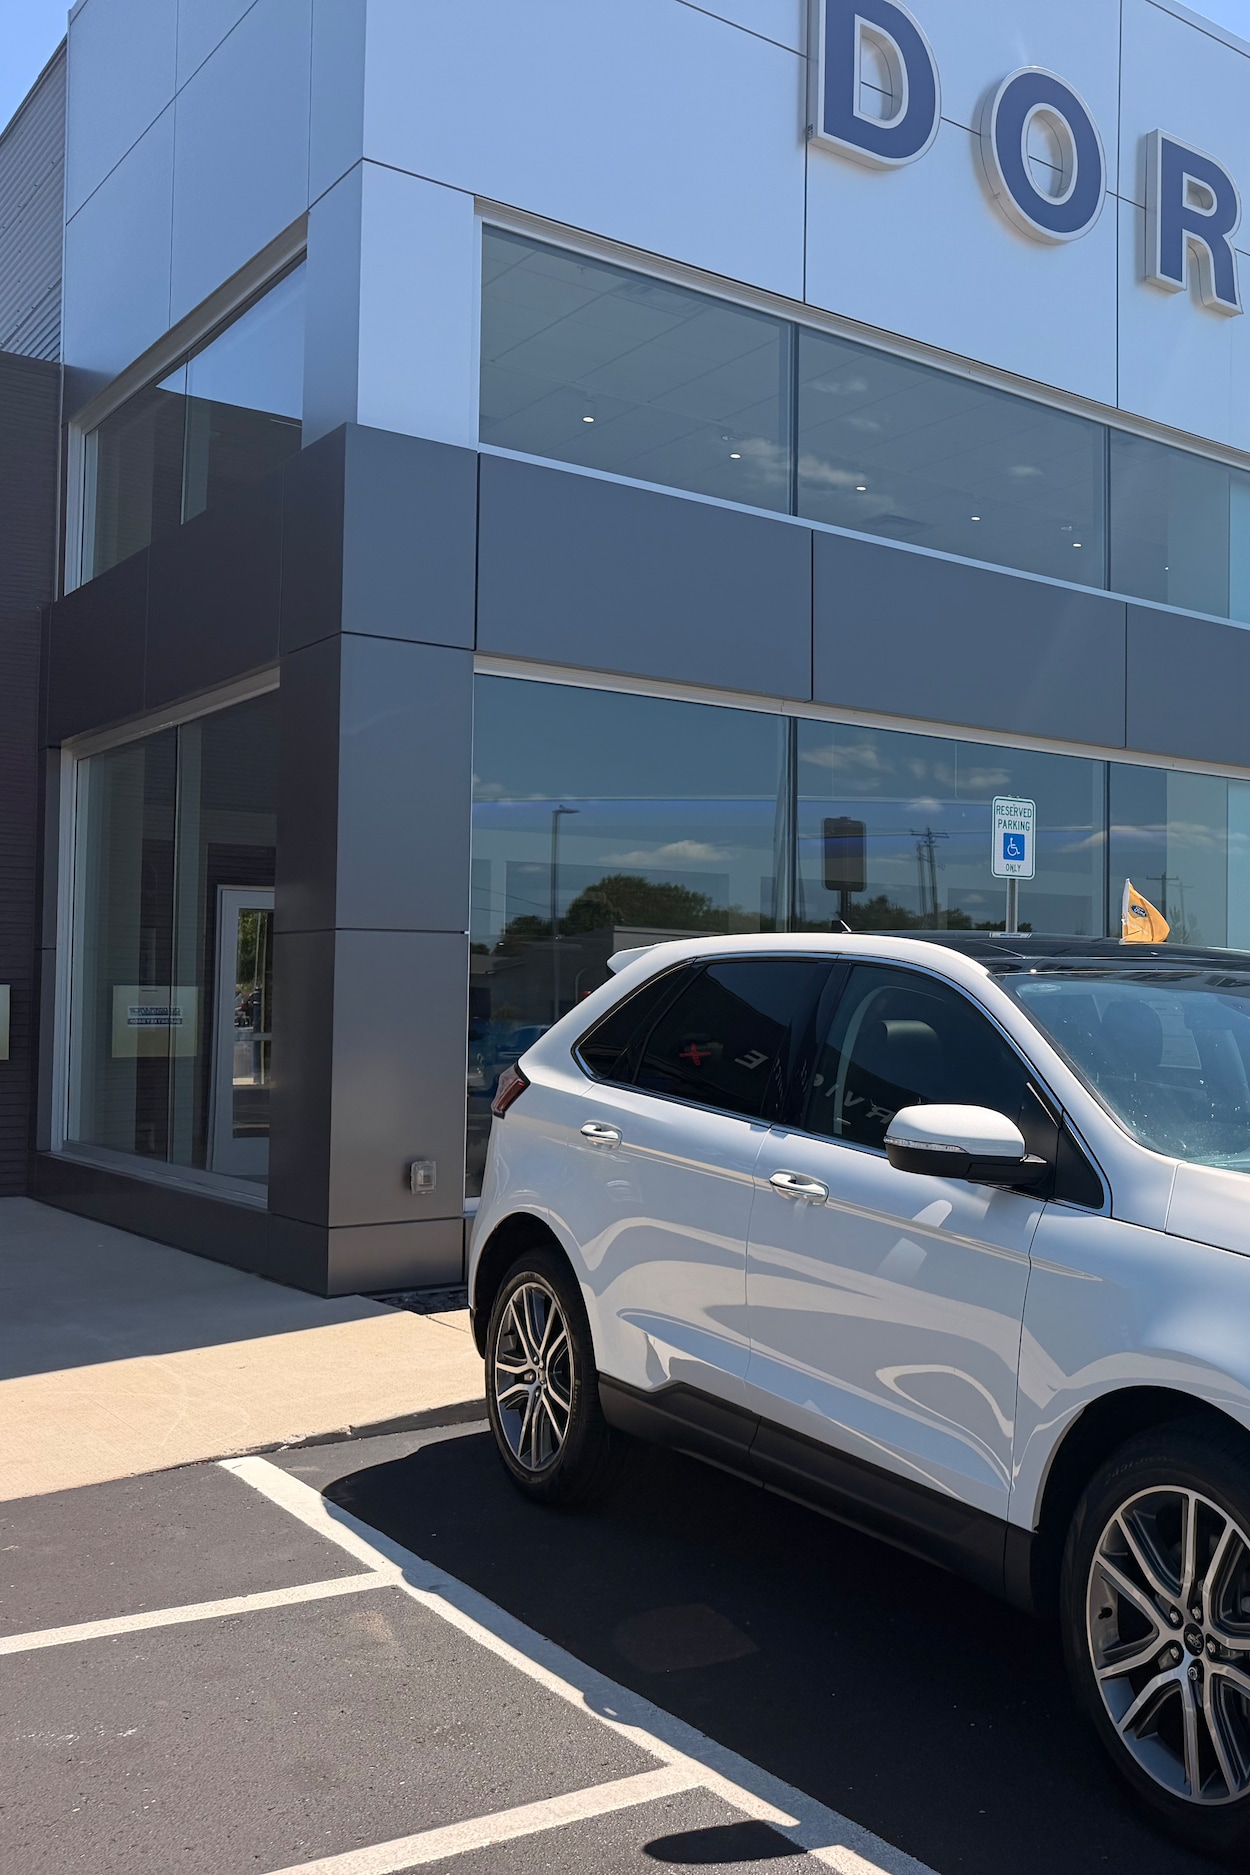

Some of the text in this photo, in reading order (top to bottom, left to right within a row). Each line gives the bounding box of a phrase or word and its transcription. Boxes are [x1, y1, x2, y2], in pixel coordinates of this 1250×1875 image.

[996, 805, 1032, 818] RESERVED
[998, 819, 1030, 831] PARKING
[1006, 863, 1021, 873] ONLY
